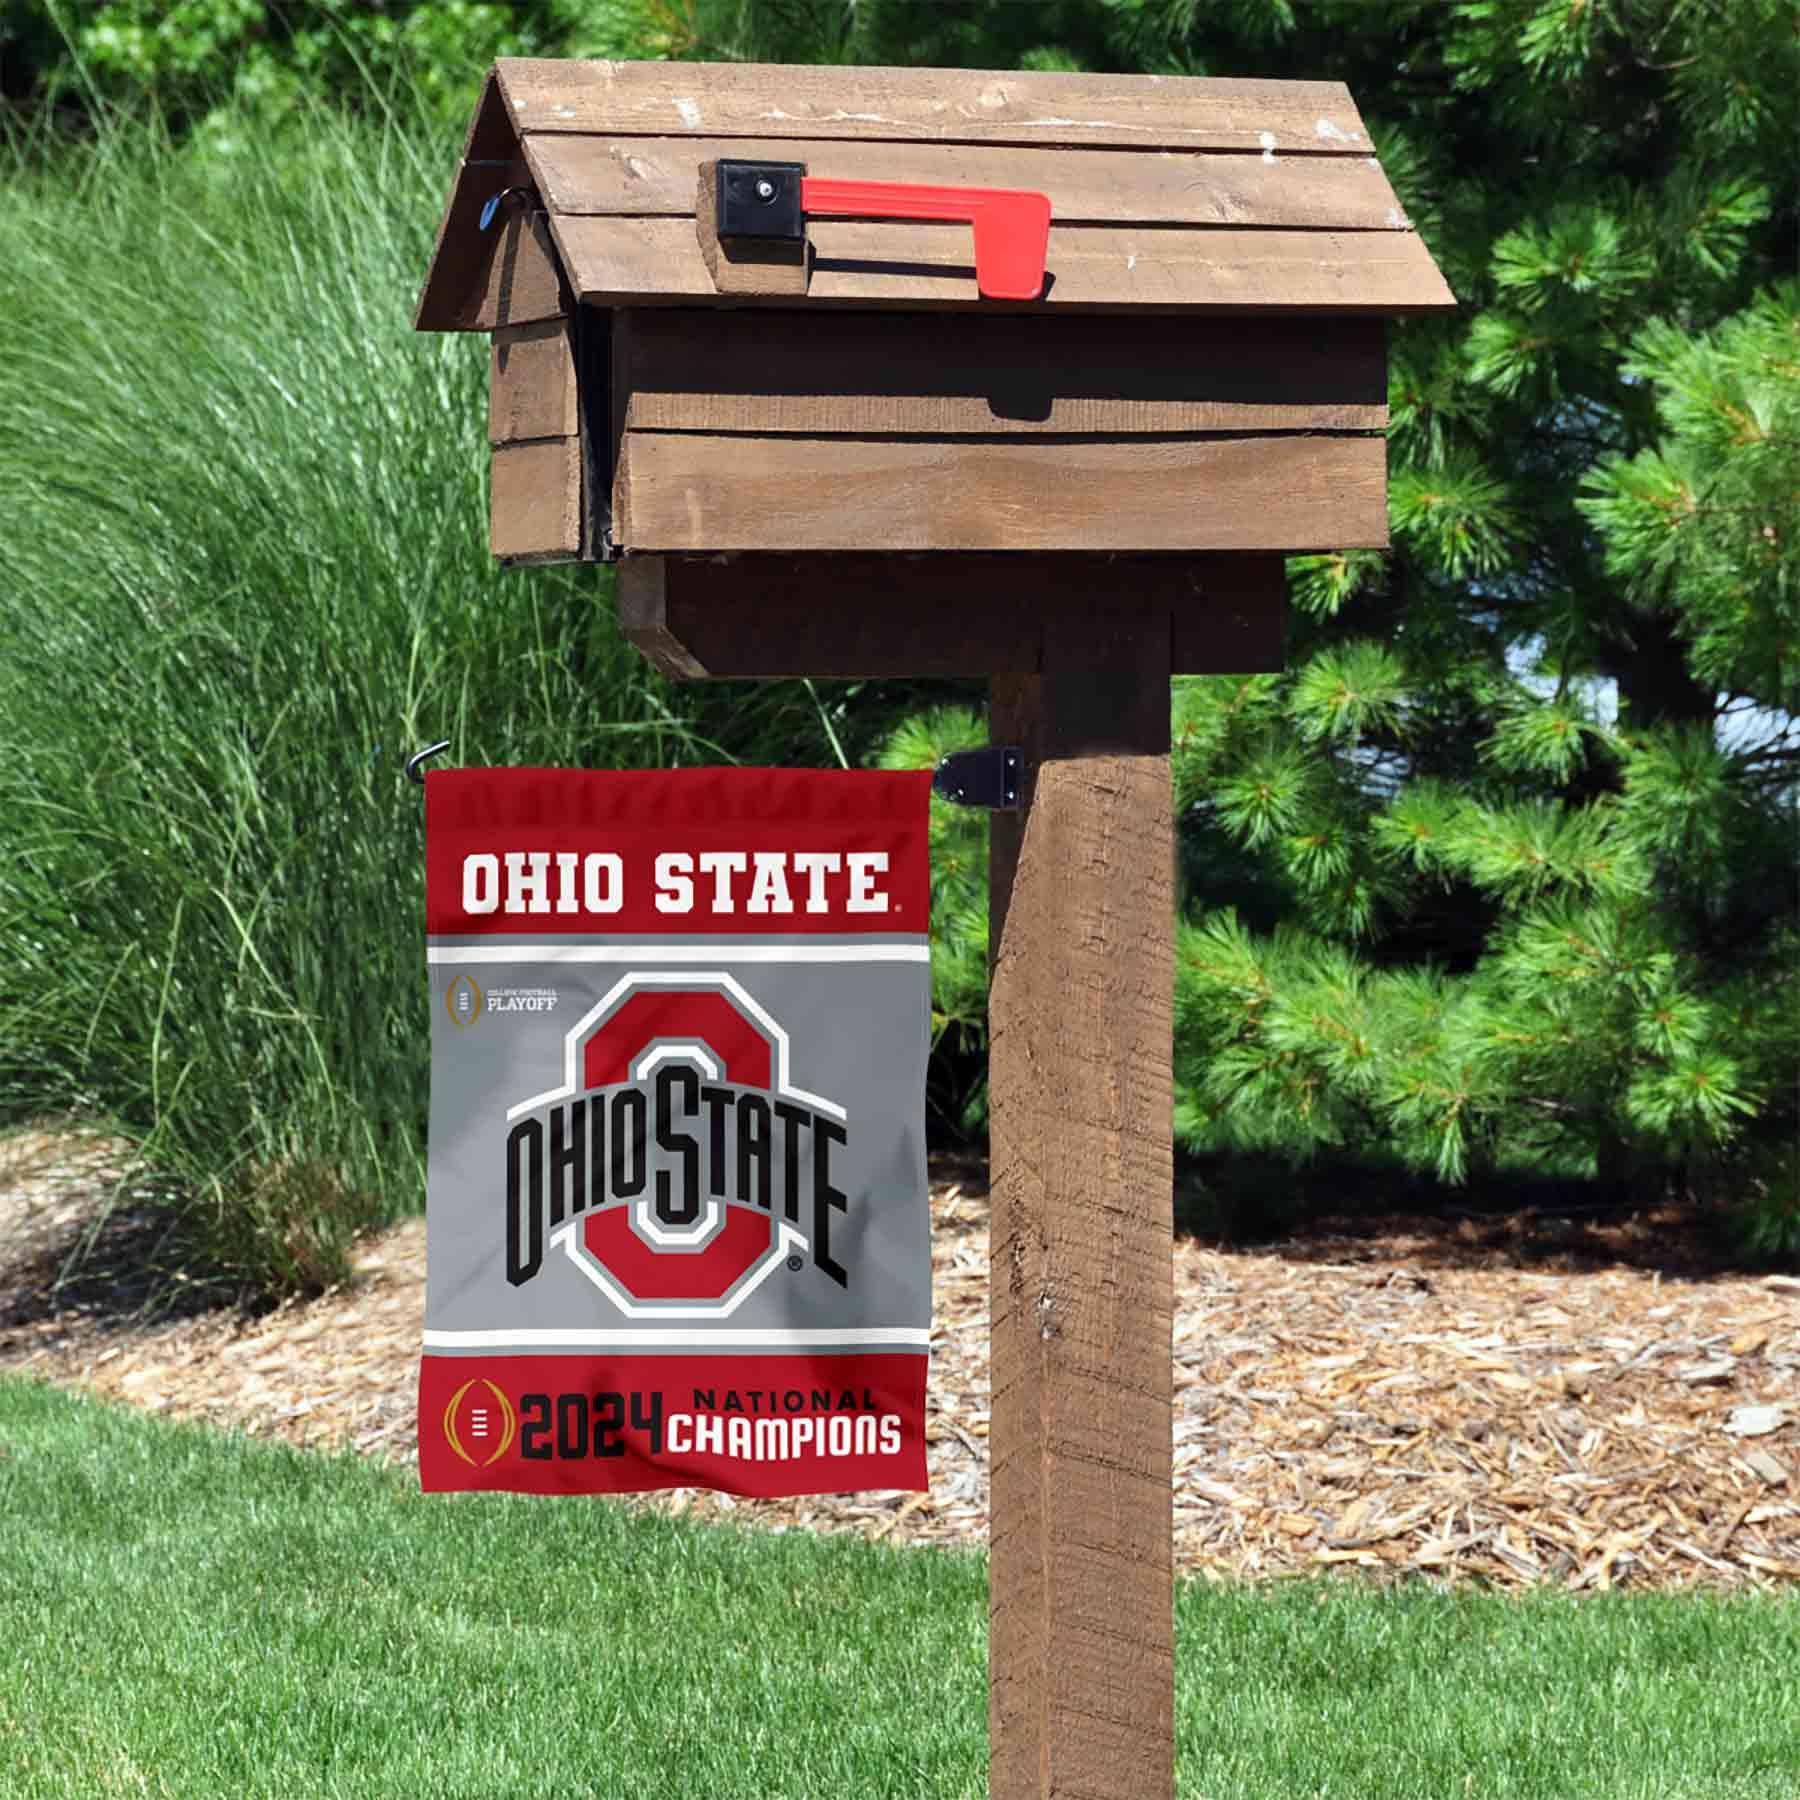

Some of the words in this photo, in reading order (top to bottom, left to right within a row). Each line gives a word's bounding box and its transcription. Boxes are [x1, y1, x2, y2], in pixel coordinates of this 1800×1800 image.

[462, 852, 624, 915] OHIO
[654, 852, 889, 914] STATE
[487, 997, 559, 1011] PLAYOFF
[693, 1388, 877, 1413] NATIONAL
[520, 1391, 663, 1461] 2024
[667, 1413, 901, 1462] CHAMPIONS
